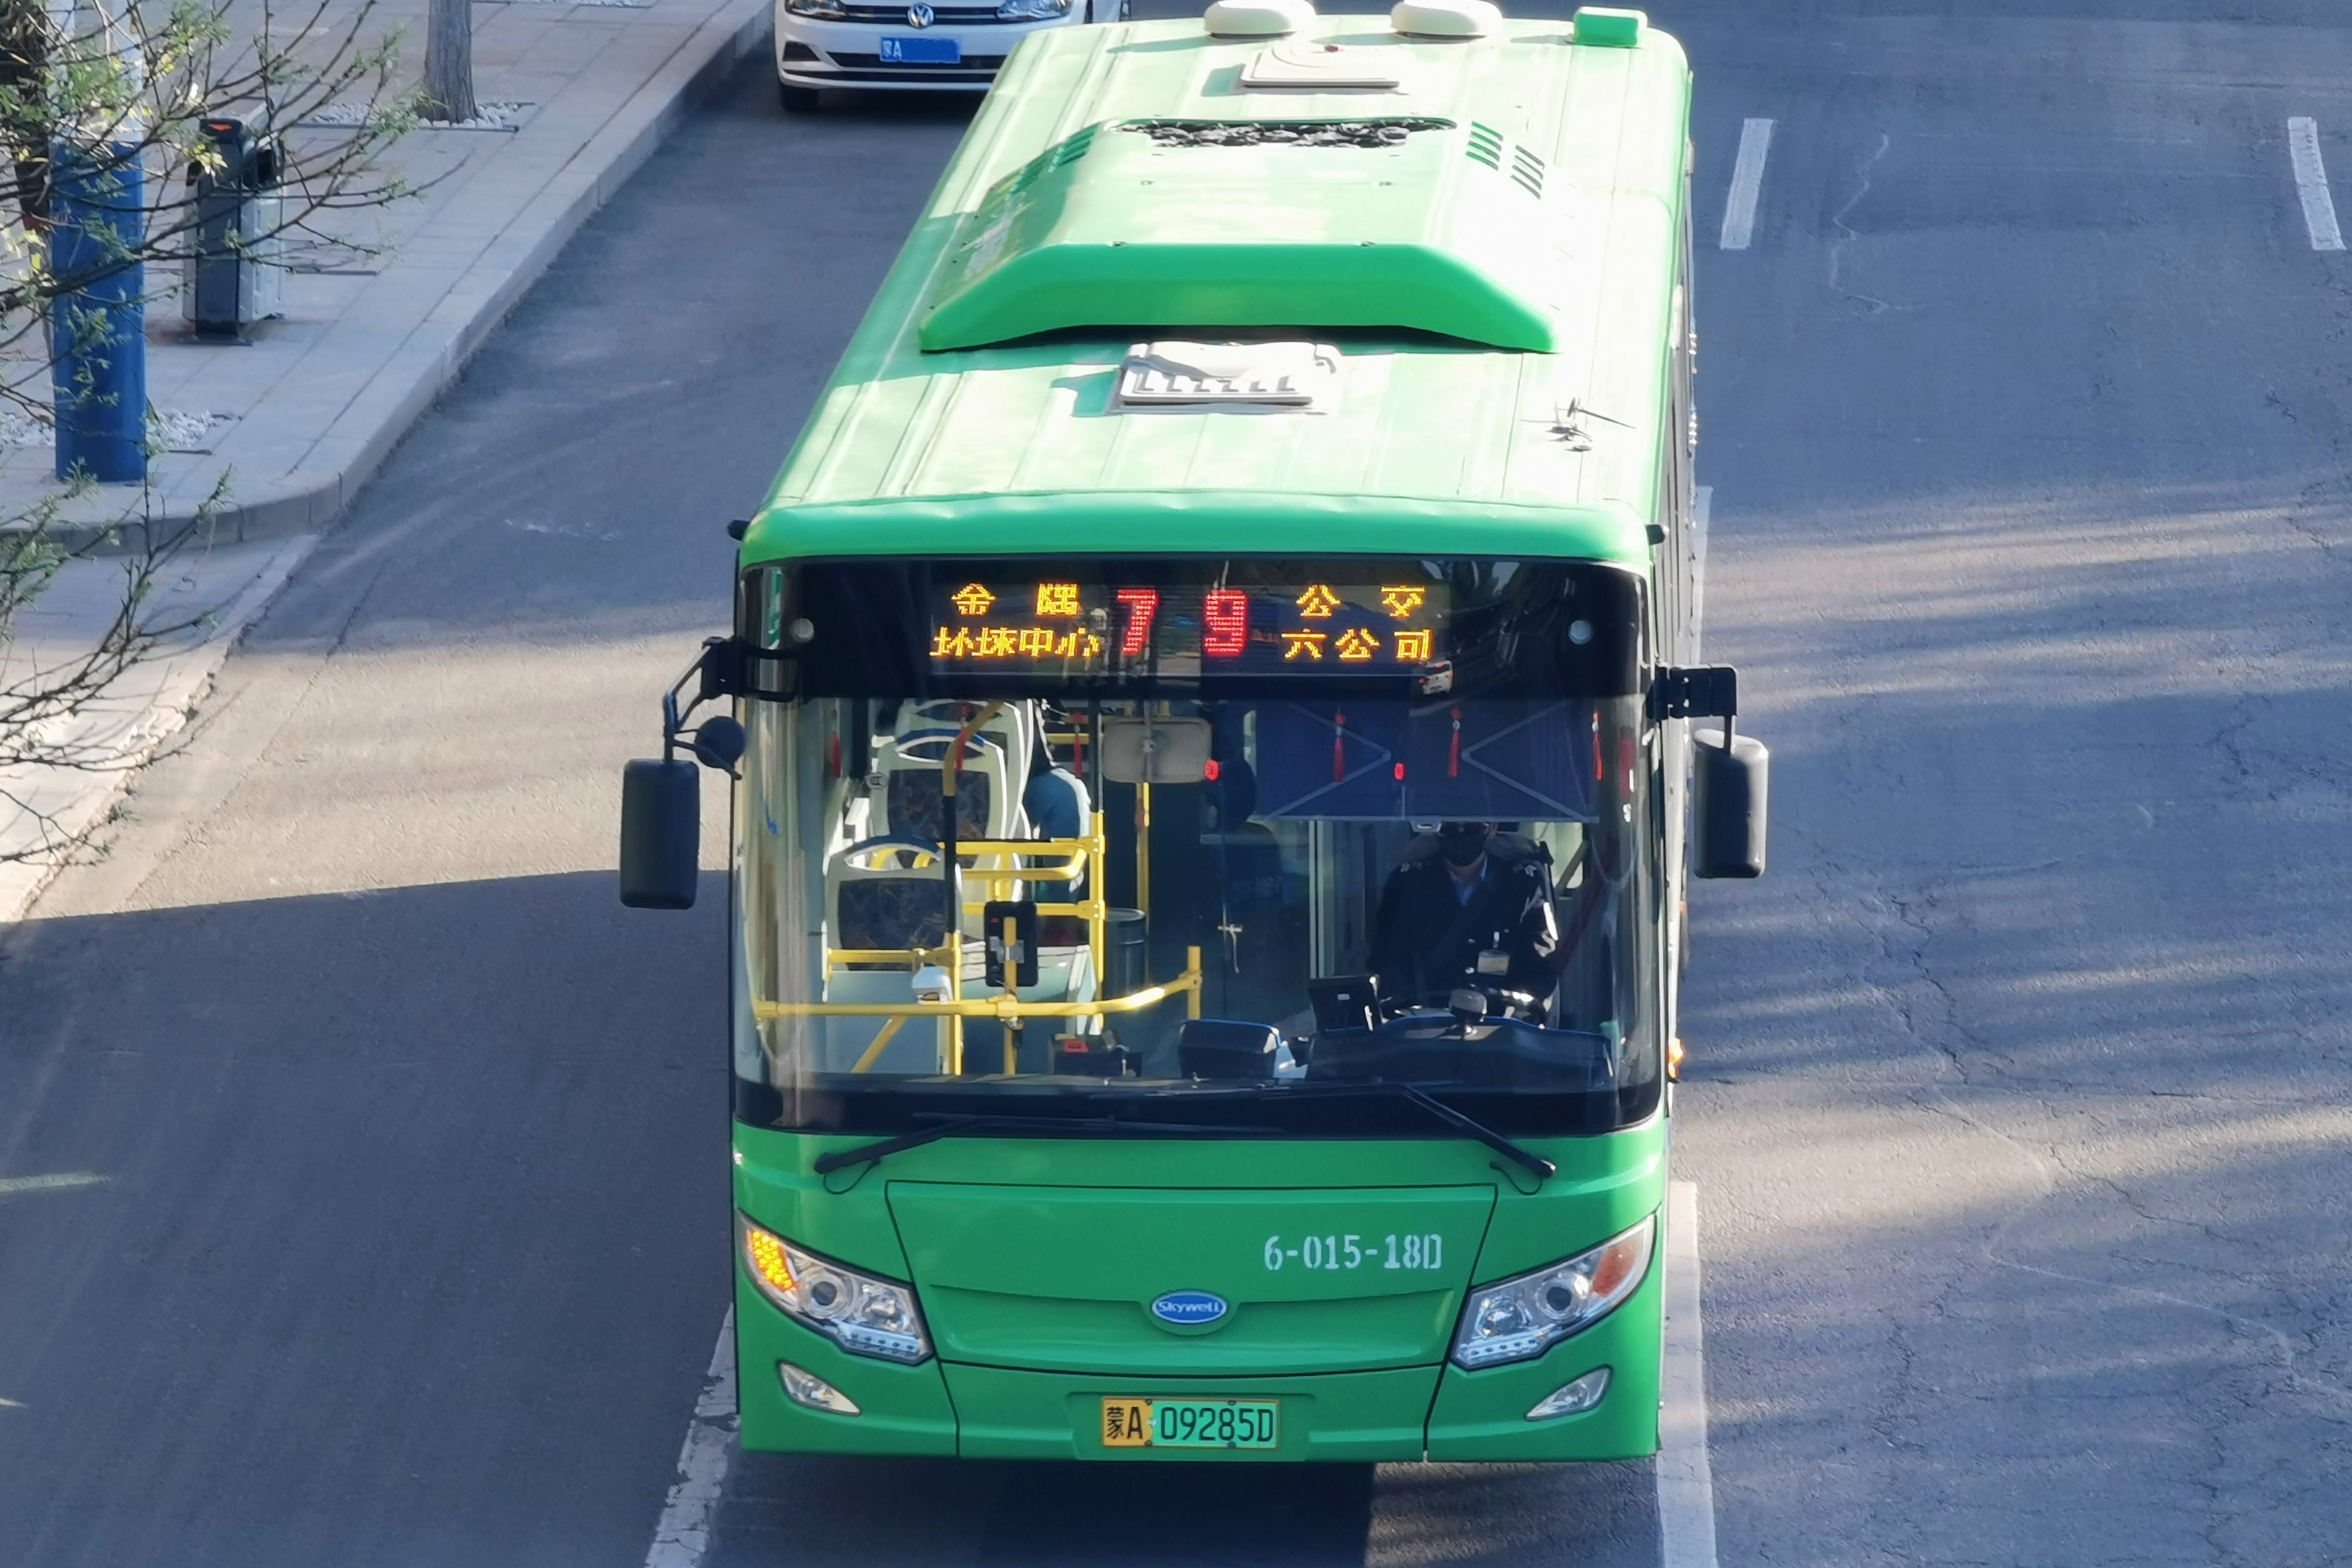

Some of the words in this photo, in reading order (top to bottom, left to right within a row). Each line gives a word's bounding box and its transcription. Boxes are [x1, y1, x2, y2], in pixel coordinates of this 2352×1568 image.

[1296, 584, 1425, 617] 公交
[1281, 629, 1434, 660] 六公司
[1158, 1301, 1220, 1314] Skywell
